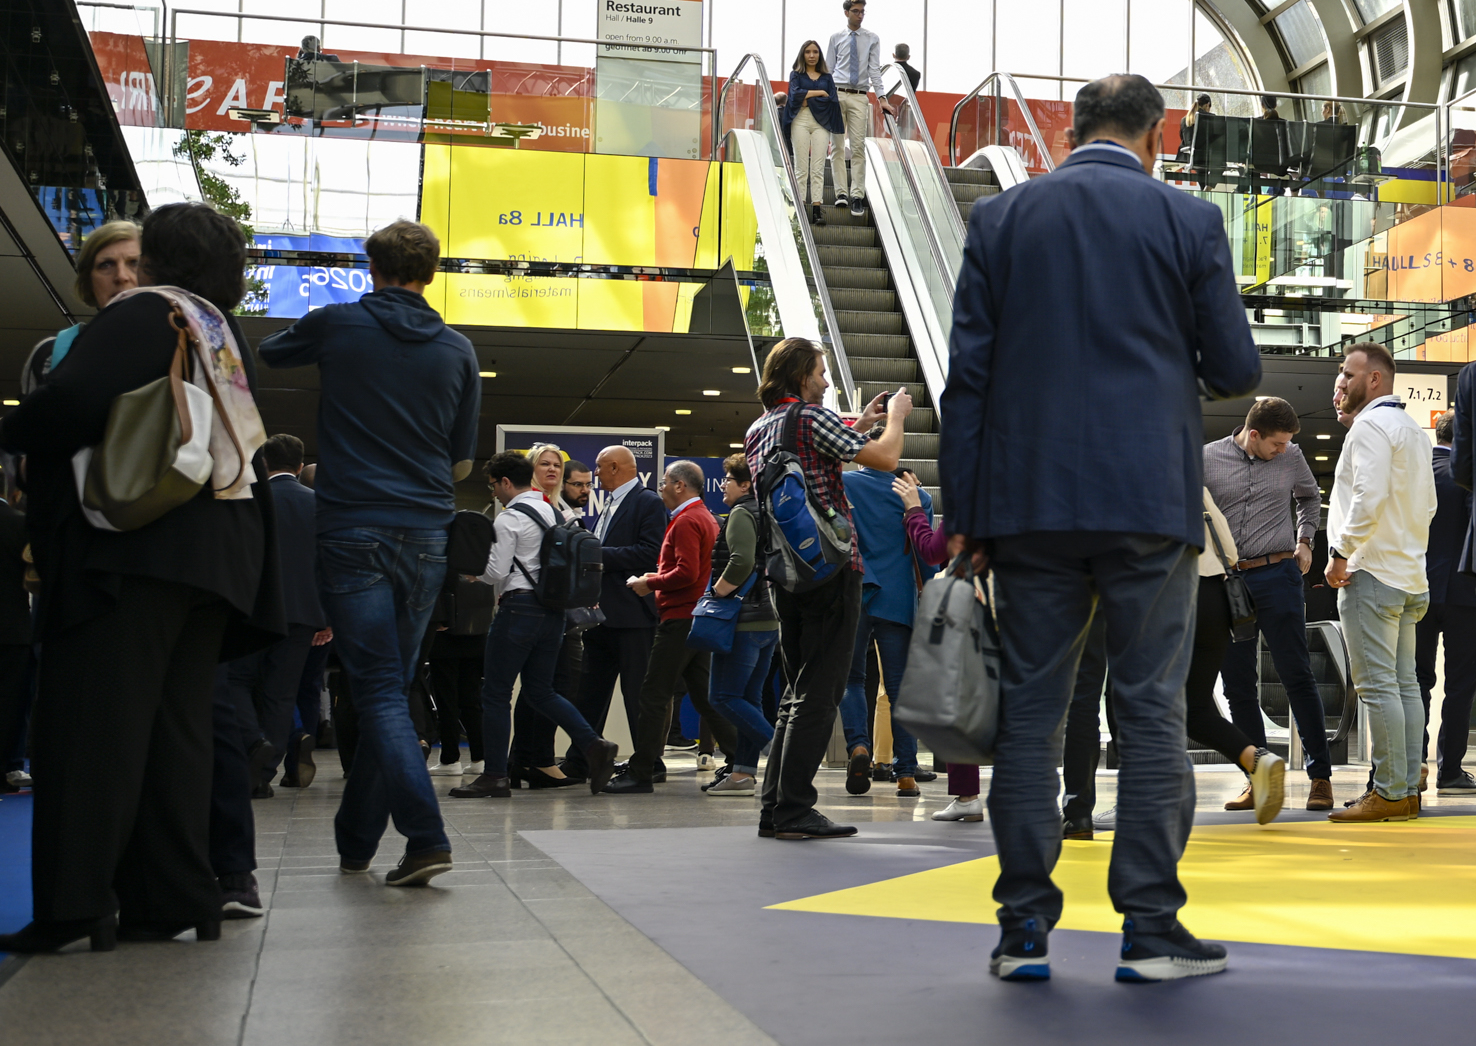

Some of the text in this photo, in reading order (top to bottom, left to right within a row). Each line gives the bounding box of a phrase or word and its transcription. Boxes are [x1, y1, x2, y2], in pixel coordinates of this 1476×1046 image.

[606, 0, 681, 17] Restaurant
[606, 14, 619, 22] Hall
[605, 33, 624, 41] open
[626, 34, 644, 42] from
[538, 121, 590, 138] busine
[622, 439, 653, 447] interpack
